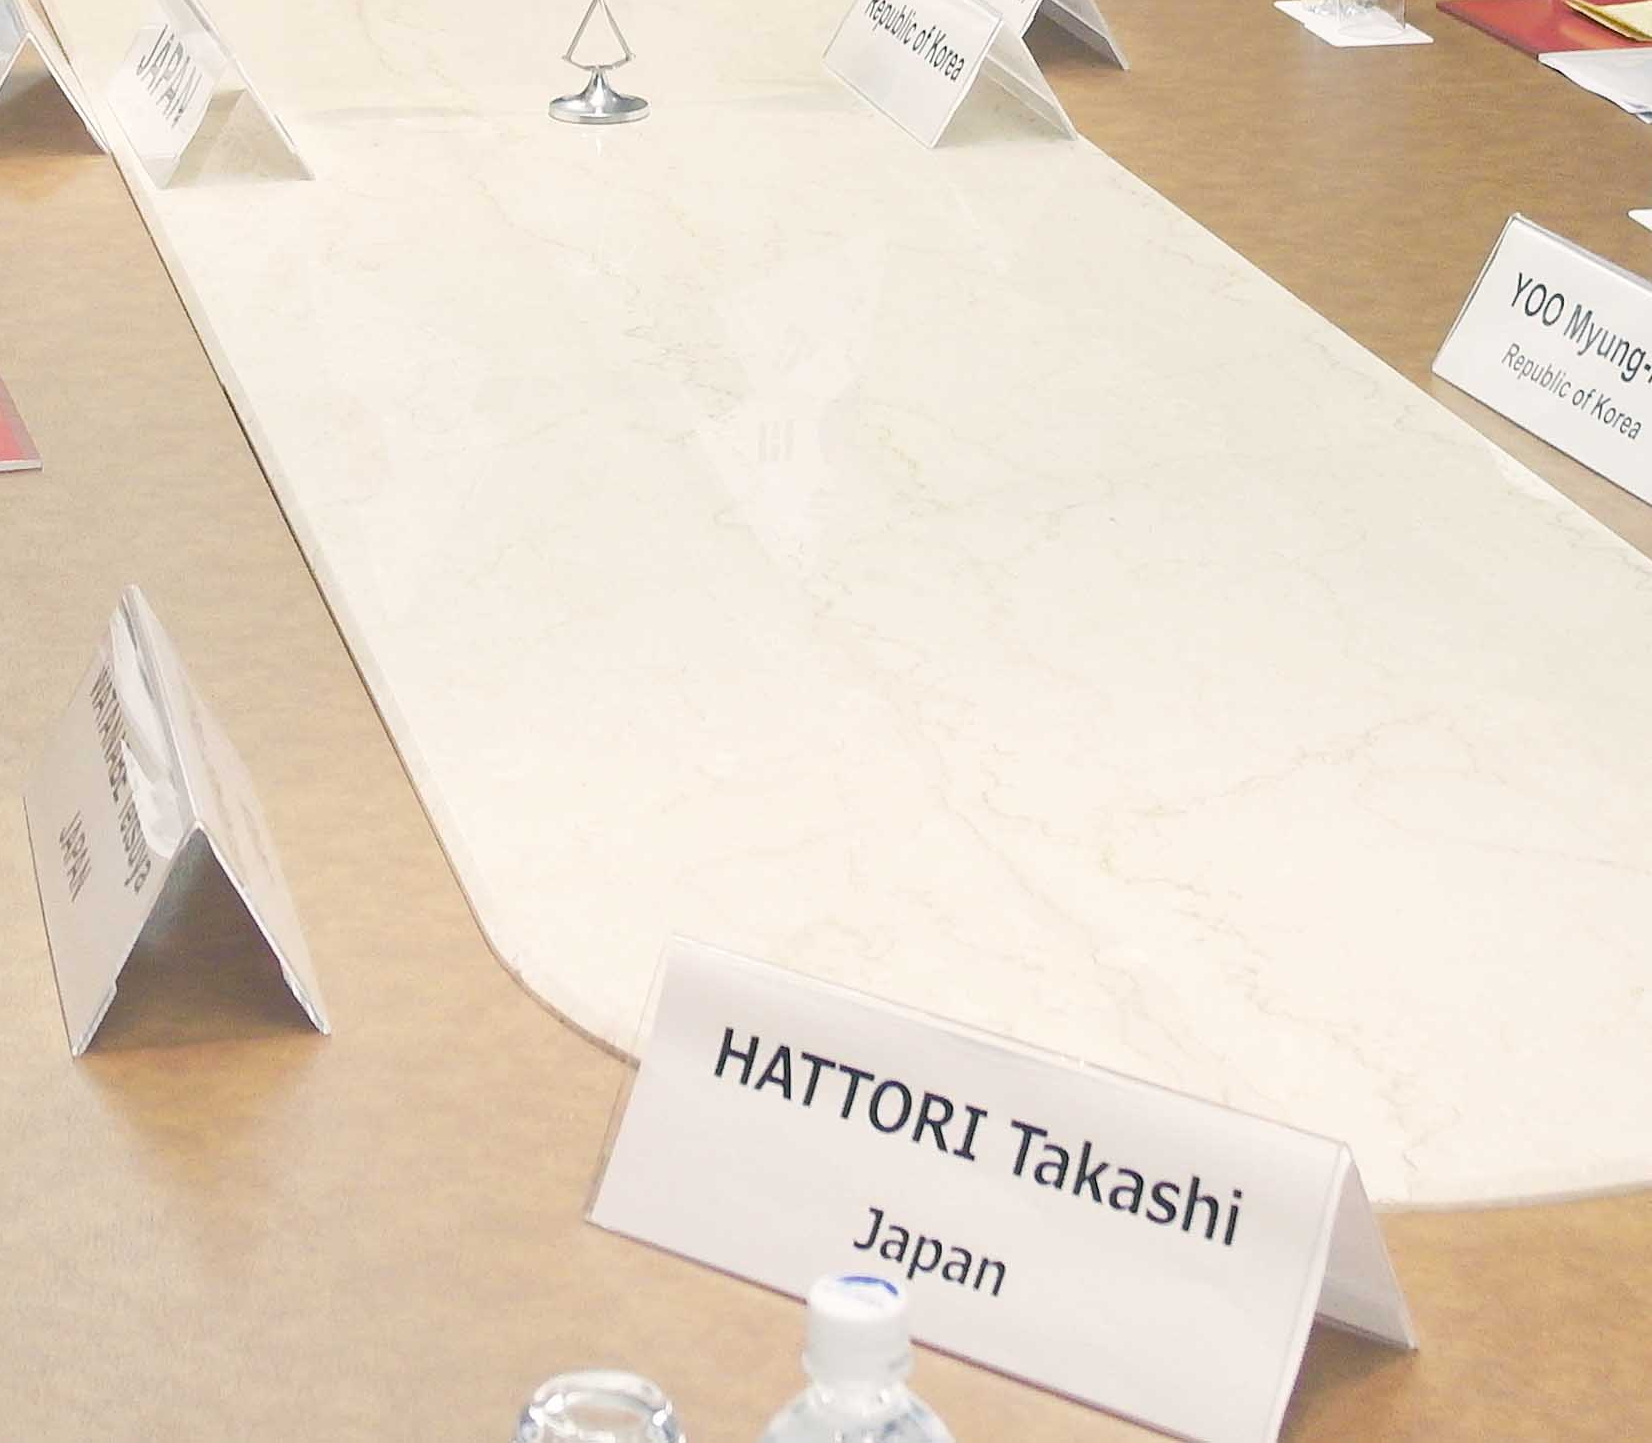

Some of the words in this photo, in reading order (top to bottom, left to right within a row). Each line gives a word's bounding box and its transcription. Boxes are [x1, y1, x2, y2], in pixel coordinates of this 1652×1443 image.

[136, 23, 203, 129] JAPAN
[912, 25, 936, 55] of
[924, 30, 965, 81] Korea
[1511, 272, 1565, 326] YOO
[1501, 343, 1572, 398] Republic
[1572, 388, 1596, 410] of
[1590, 394, 1642, 440] Korea
[714, 1026, 988, 1163] HATTORI
[1006, 1119, 1244, 1246] Takashi
[852, 1205, 1009, 1299] Japan
